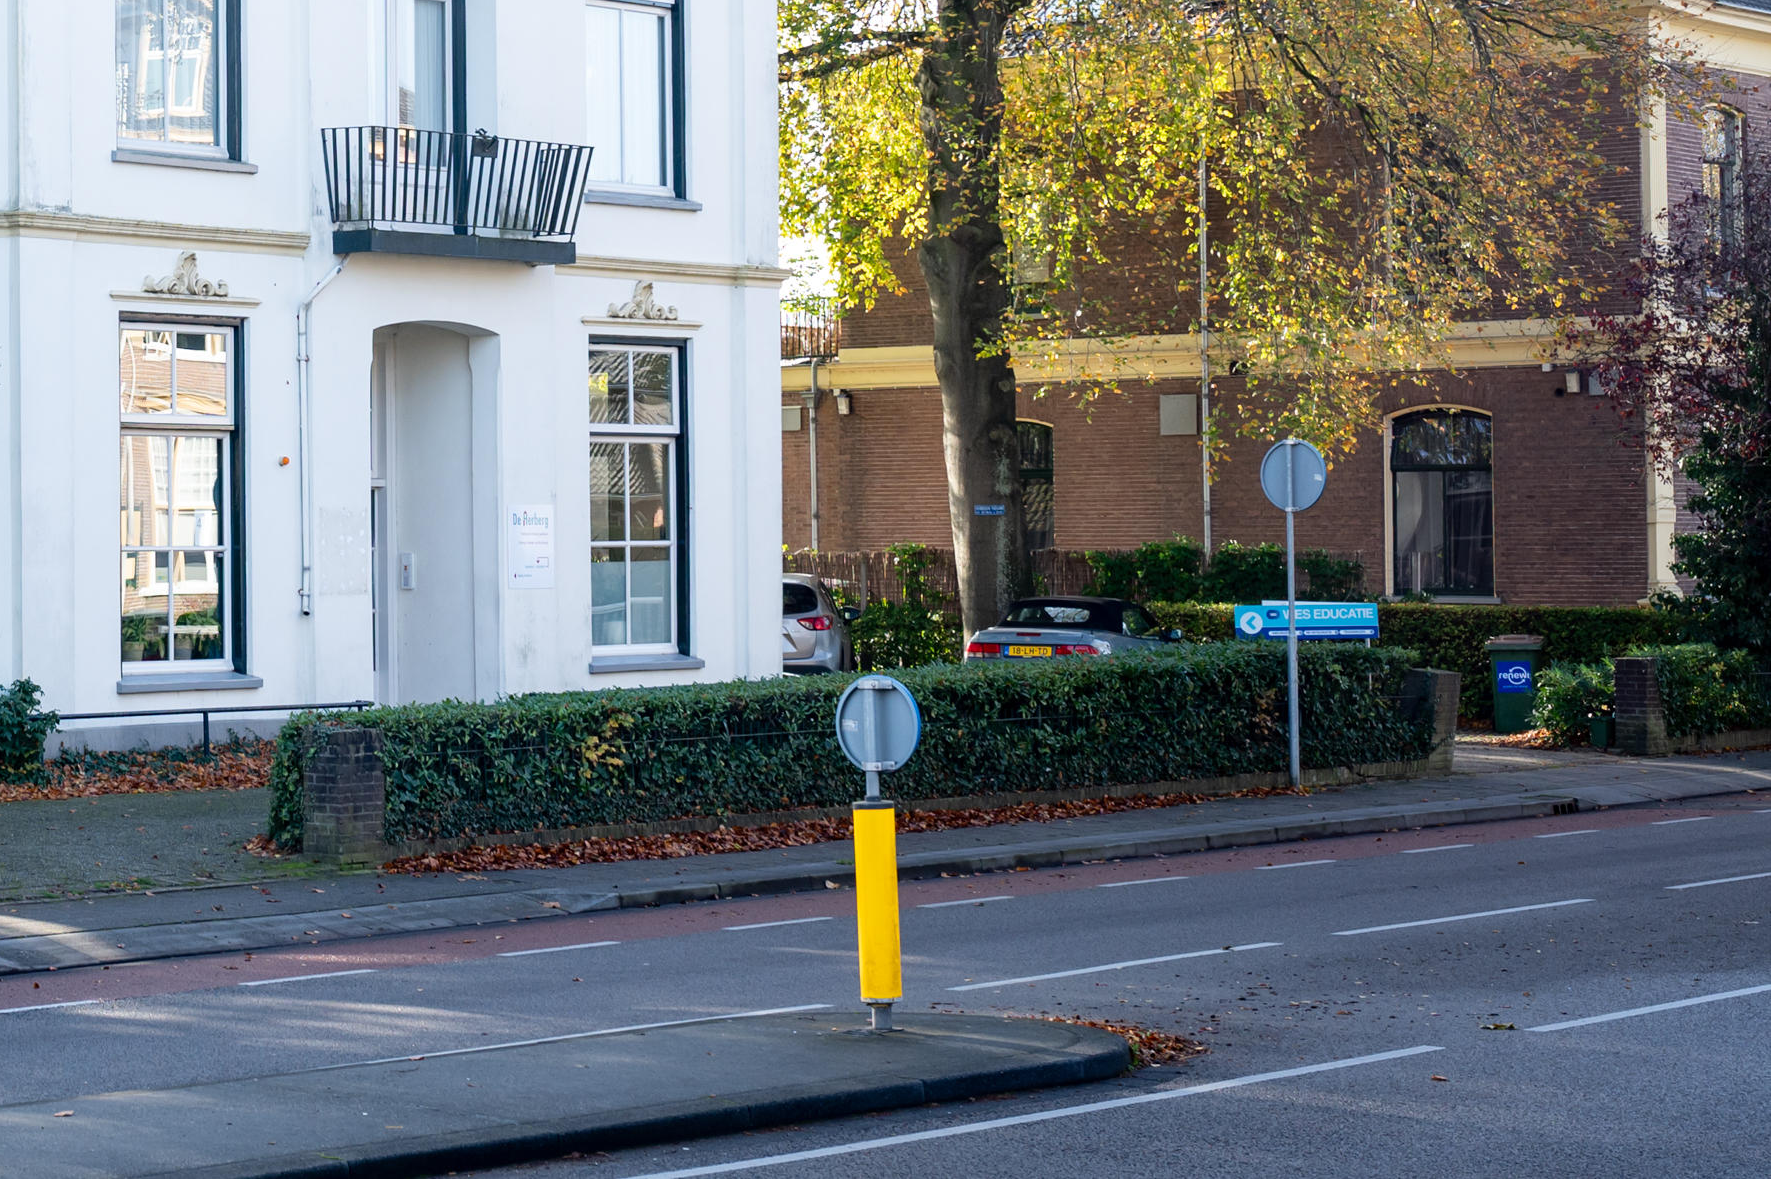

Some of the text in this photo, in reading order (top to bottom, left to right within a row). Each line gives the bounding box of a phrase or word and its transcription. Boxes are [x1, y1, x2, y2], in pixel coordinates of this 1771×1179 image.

[512, 511, 549, 529] De Herberg
[1313, 608, 1374, 620] EDUCATIE
